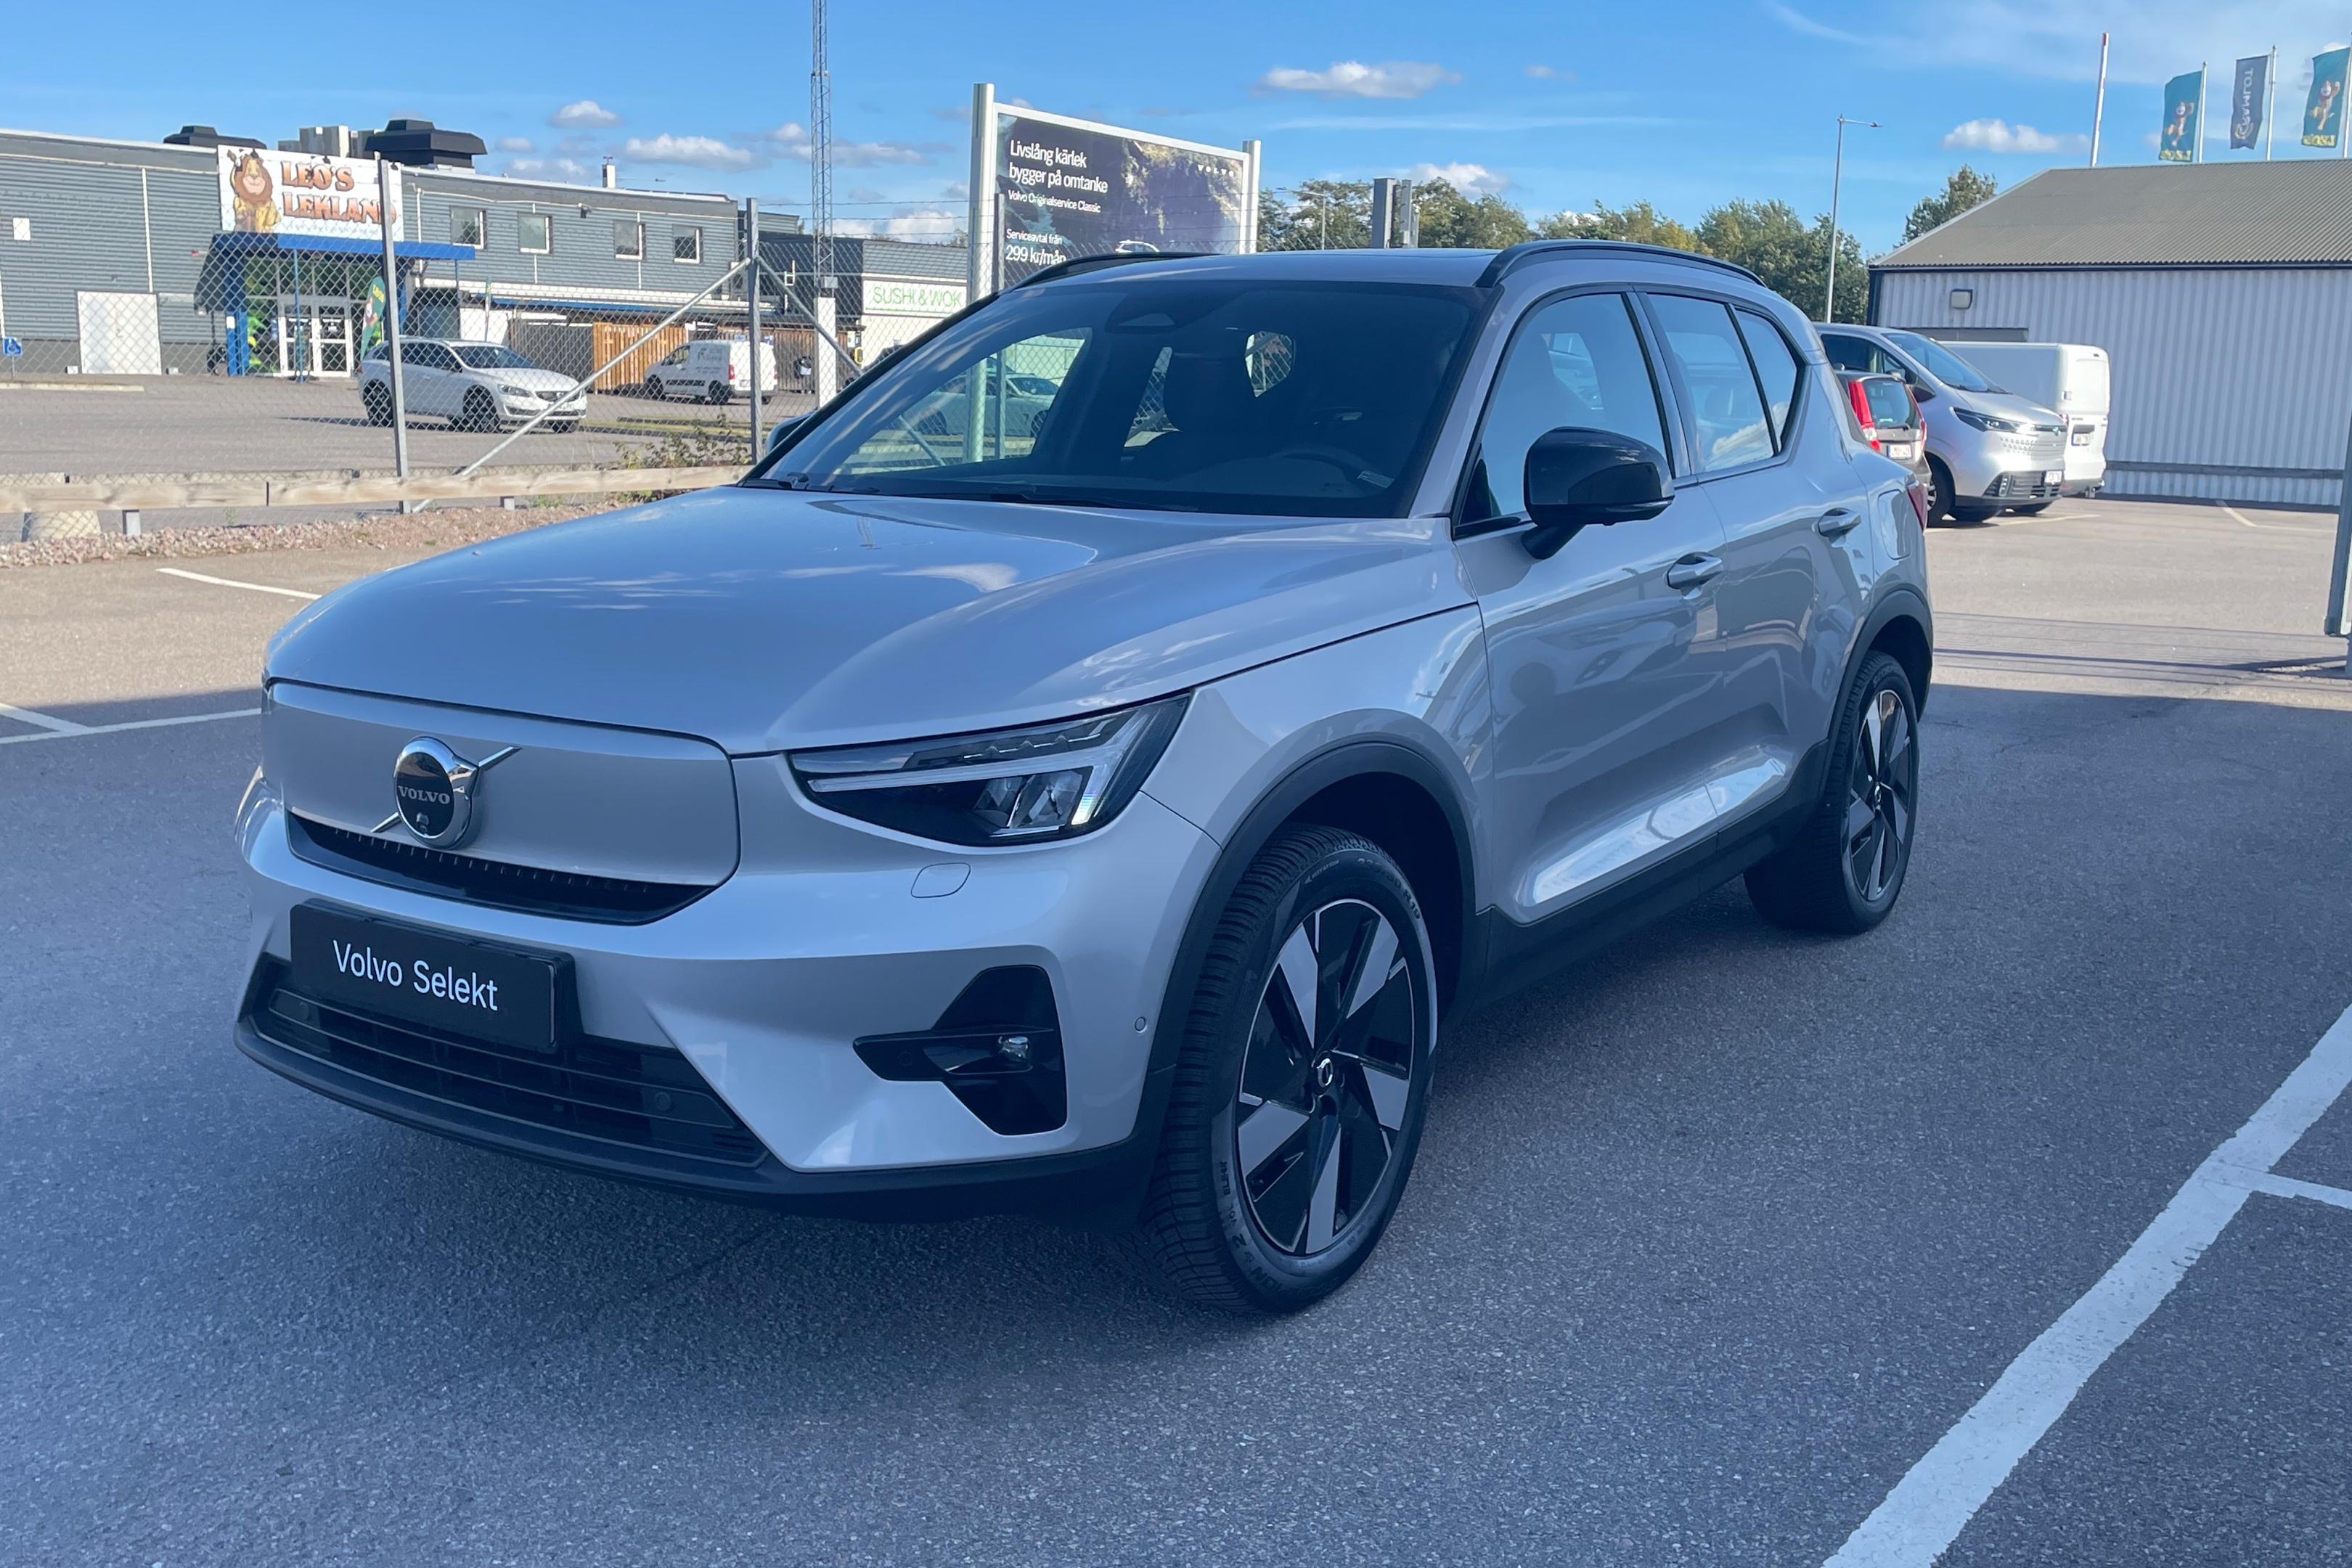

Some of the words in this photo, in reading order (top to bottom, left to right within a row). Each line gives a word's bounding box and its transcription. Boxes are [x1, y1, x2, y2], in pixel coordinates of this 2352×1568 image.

[1010, 139, 1054, 166] Livslång
[1055, 147, 1087, 168] kärlek
[281, 160, 355, 192] LEO'S
[1009, 162, 1047, 186] bygger
[1048, 169, 1062, 189] på
[1063, 176, 1108, 194] omtanke
[1197, 163, 1234, 177] VOLVO
[1008, 189, 1027, 203] Volvo
[1028, 193, 1077, 210] Originalservice
[1078, 200, 1101, 213] Classic
[1006, 229, 1048, 243] Serviceavtal
[1048, 234, 1063, 245] från
[1005, 245, 1029, 262] 299
[1029, 248, 1067, 266] kr/mån
[873, 286, 915, 305] SUSHI
[918, 290, 928, 306] &
[929, 290, 963, 308] WOK
[397, 785, 450, 804] VOLVO
[332, 940, 402, 987] Volvo
[413, 960, 499, 1011] Selekt
